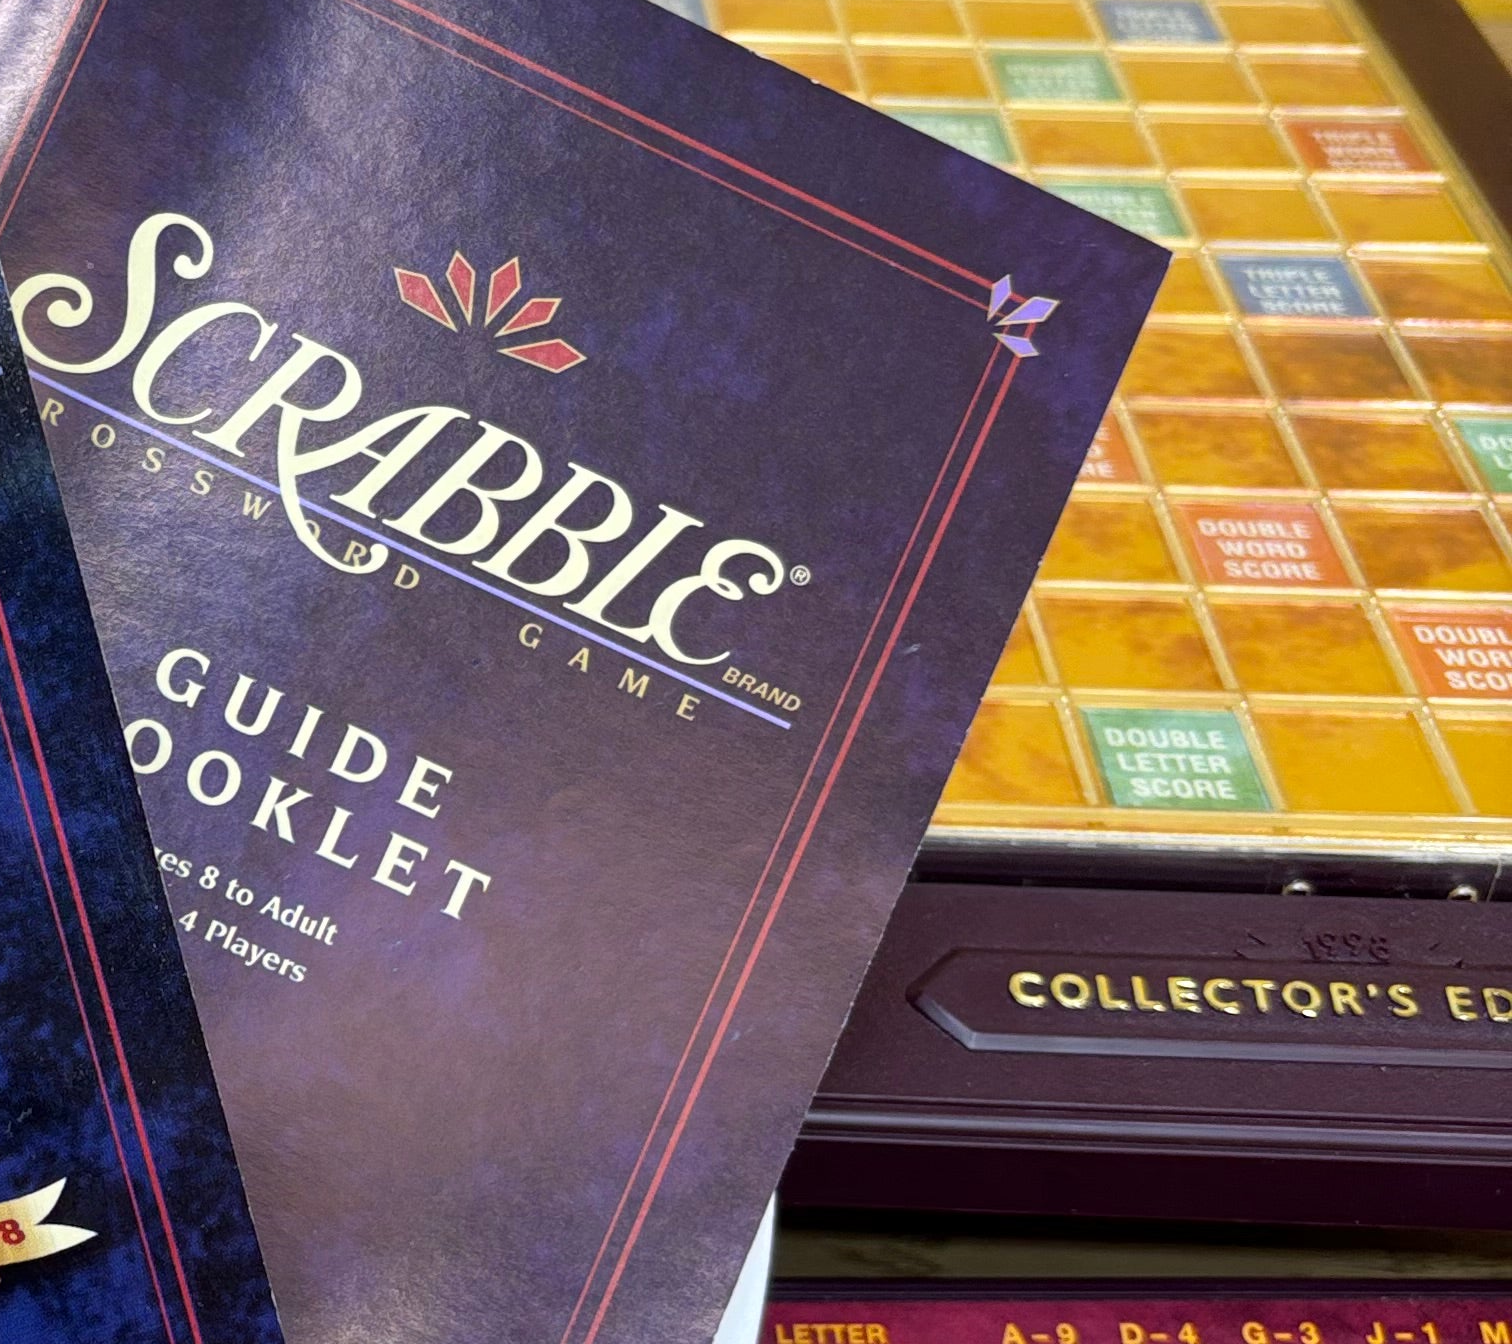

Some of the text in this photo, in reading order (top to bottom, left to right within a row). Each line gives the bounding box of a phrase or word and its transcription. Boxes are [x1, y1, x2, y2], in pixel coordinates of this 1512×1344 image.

[1197, 518, 1312, 539] DOUBLE
[1216, 538, 1308, 559] WORD
[1223, 559, 1321, 580] SCORE
[1433, 647, 1512, 669] WOR
[518, 623, 701, 722] GAME
[1443, 670, 1512, 691] SCO
[721, 666, 802, 713] BRAND
[156, 648, 454, 819] GUIDE
[1103, 727, 1227, 749] DOUBLE
[1116, 752, 1232, 774] LETTER
[1130, 777, 1237, 800] SCORE
[122, 719, 492, 920] OOKLET
[199, 865, 220, 889] 8
[225, 878, 255, 906] to
[259, 895, 338, 945] Adult
[178, 910, 307, 983] 4 Players
[1008, 971, 1420, 1019] COLLECTOR'S
